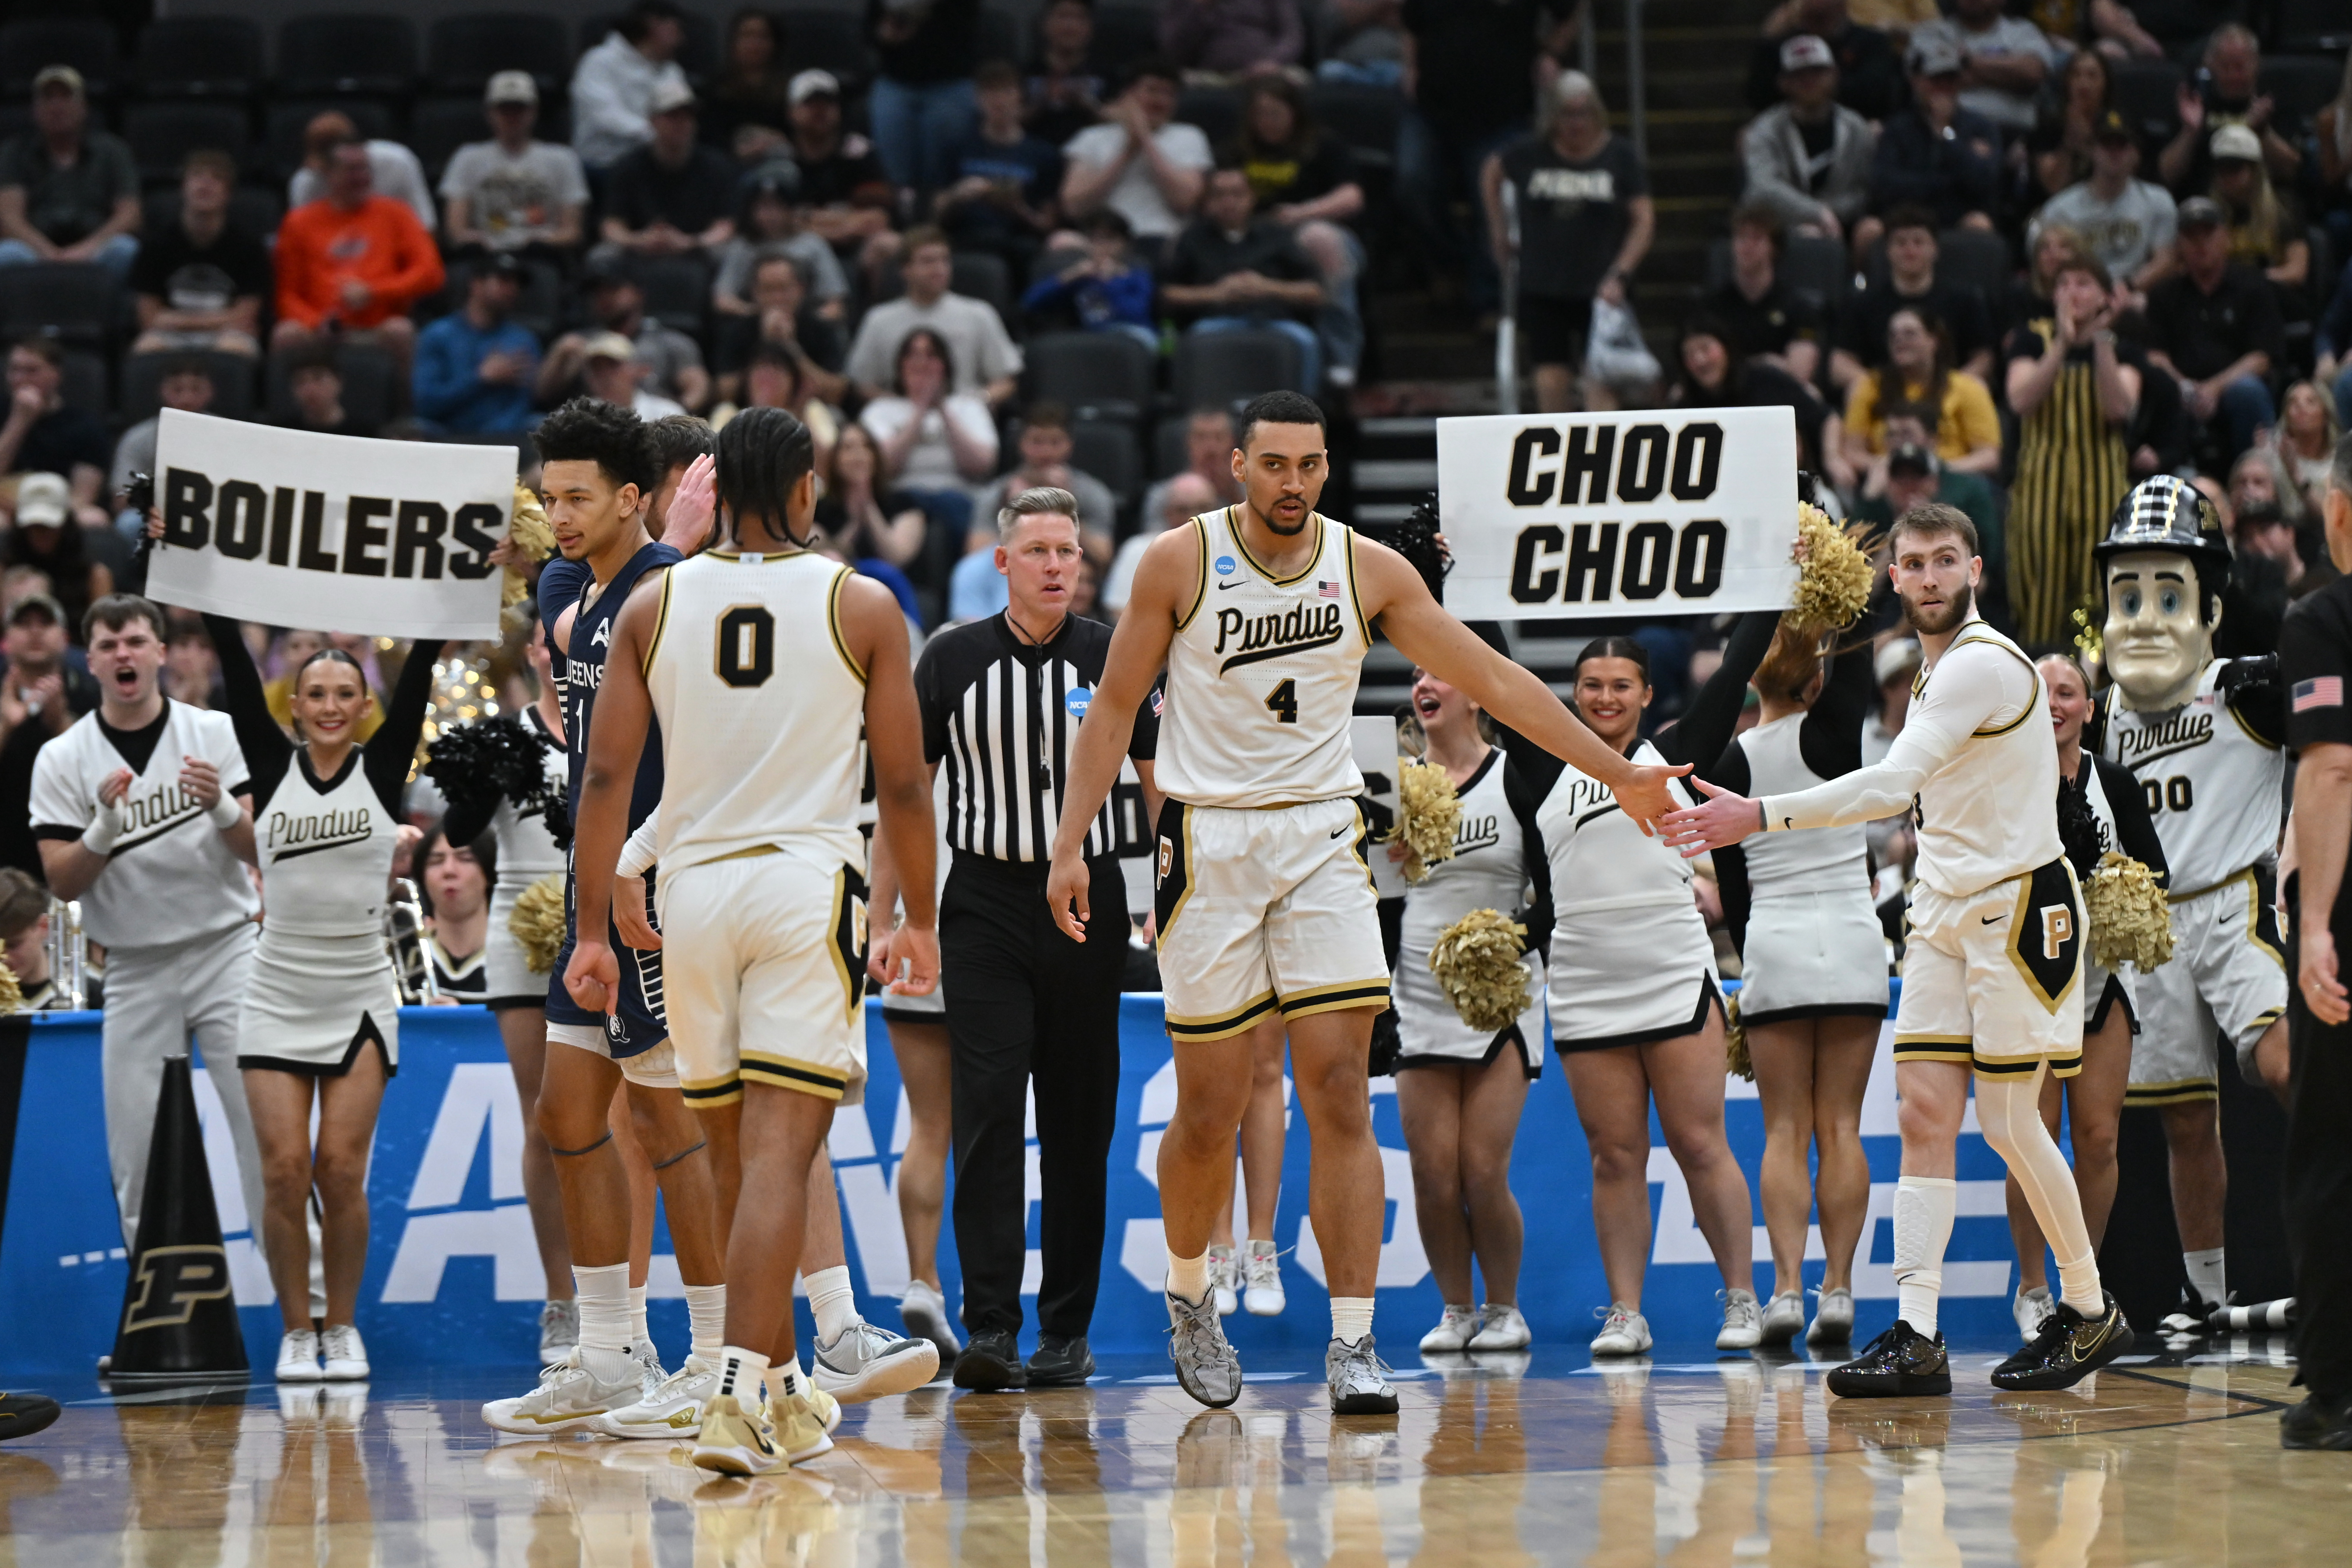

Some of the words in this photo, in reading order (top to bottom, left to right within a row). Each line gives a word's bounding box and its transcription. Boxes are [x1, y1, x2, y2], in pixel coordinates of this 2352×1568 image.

[1505, 420, 1726, 509] CHOO
[163, 466, 504, 580] BOILERS
[1507, 517, 1729, 606] CHOO
[714, 603, 775, 689] 0
[1214, 599, 1343, 655] Purdue
[1070, 701, 1090, 709] NCA
[1264, 678, 1298, 723] 4
[2118, 713, 2213, 764] Purdue
[267, 807, 371, 848] Purdue
[2040, 903, 2073, 959] P
[123, 1244, 232, 1335] P
